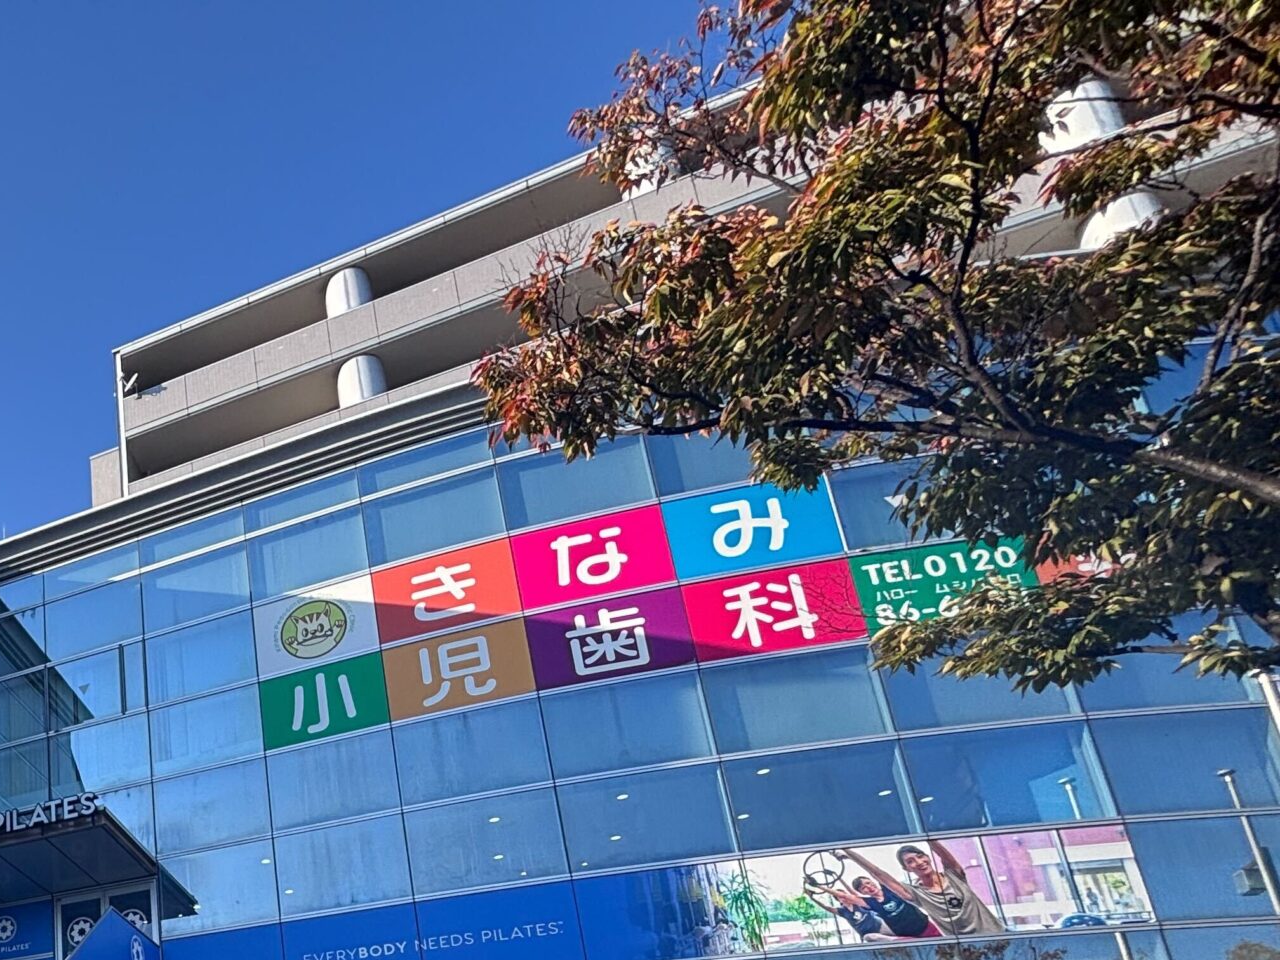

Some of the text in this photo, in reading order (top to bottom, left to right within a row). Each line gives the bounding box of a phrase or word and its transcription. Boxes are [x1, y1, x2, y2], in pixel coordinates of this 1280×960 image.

[411, 497, 789, 622] きなみ
[860, 545, 1018, 586] TEL 0120
[292, 573, 820, 734] 小児歯科
[415, 932, 474, 951] NEEDS
